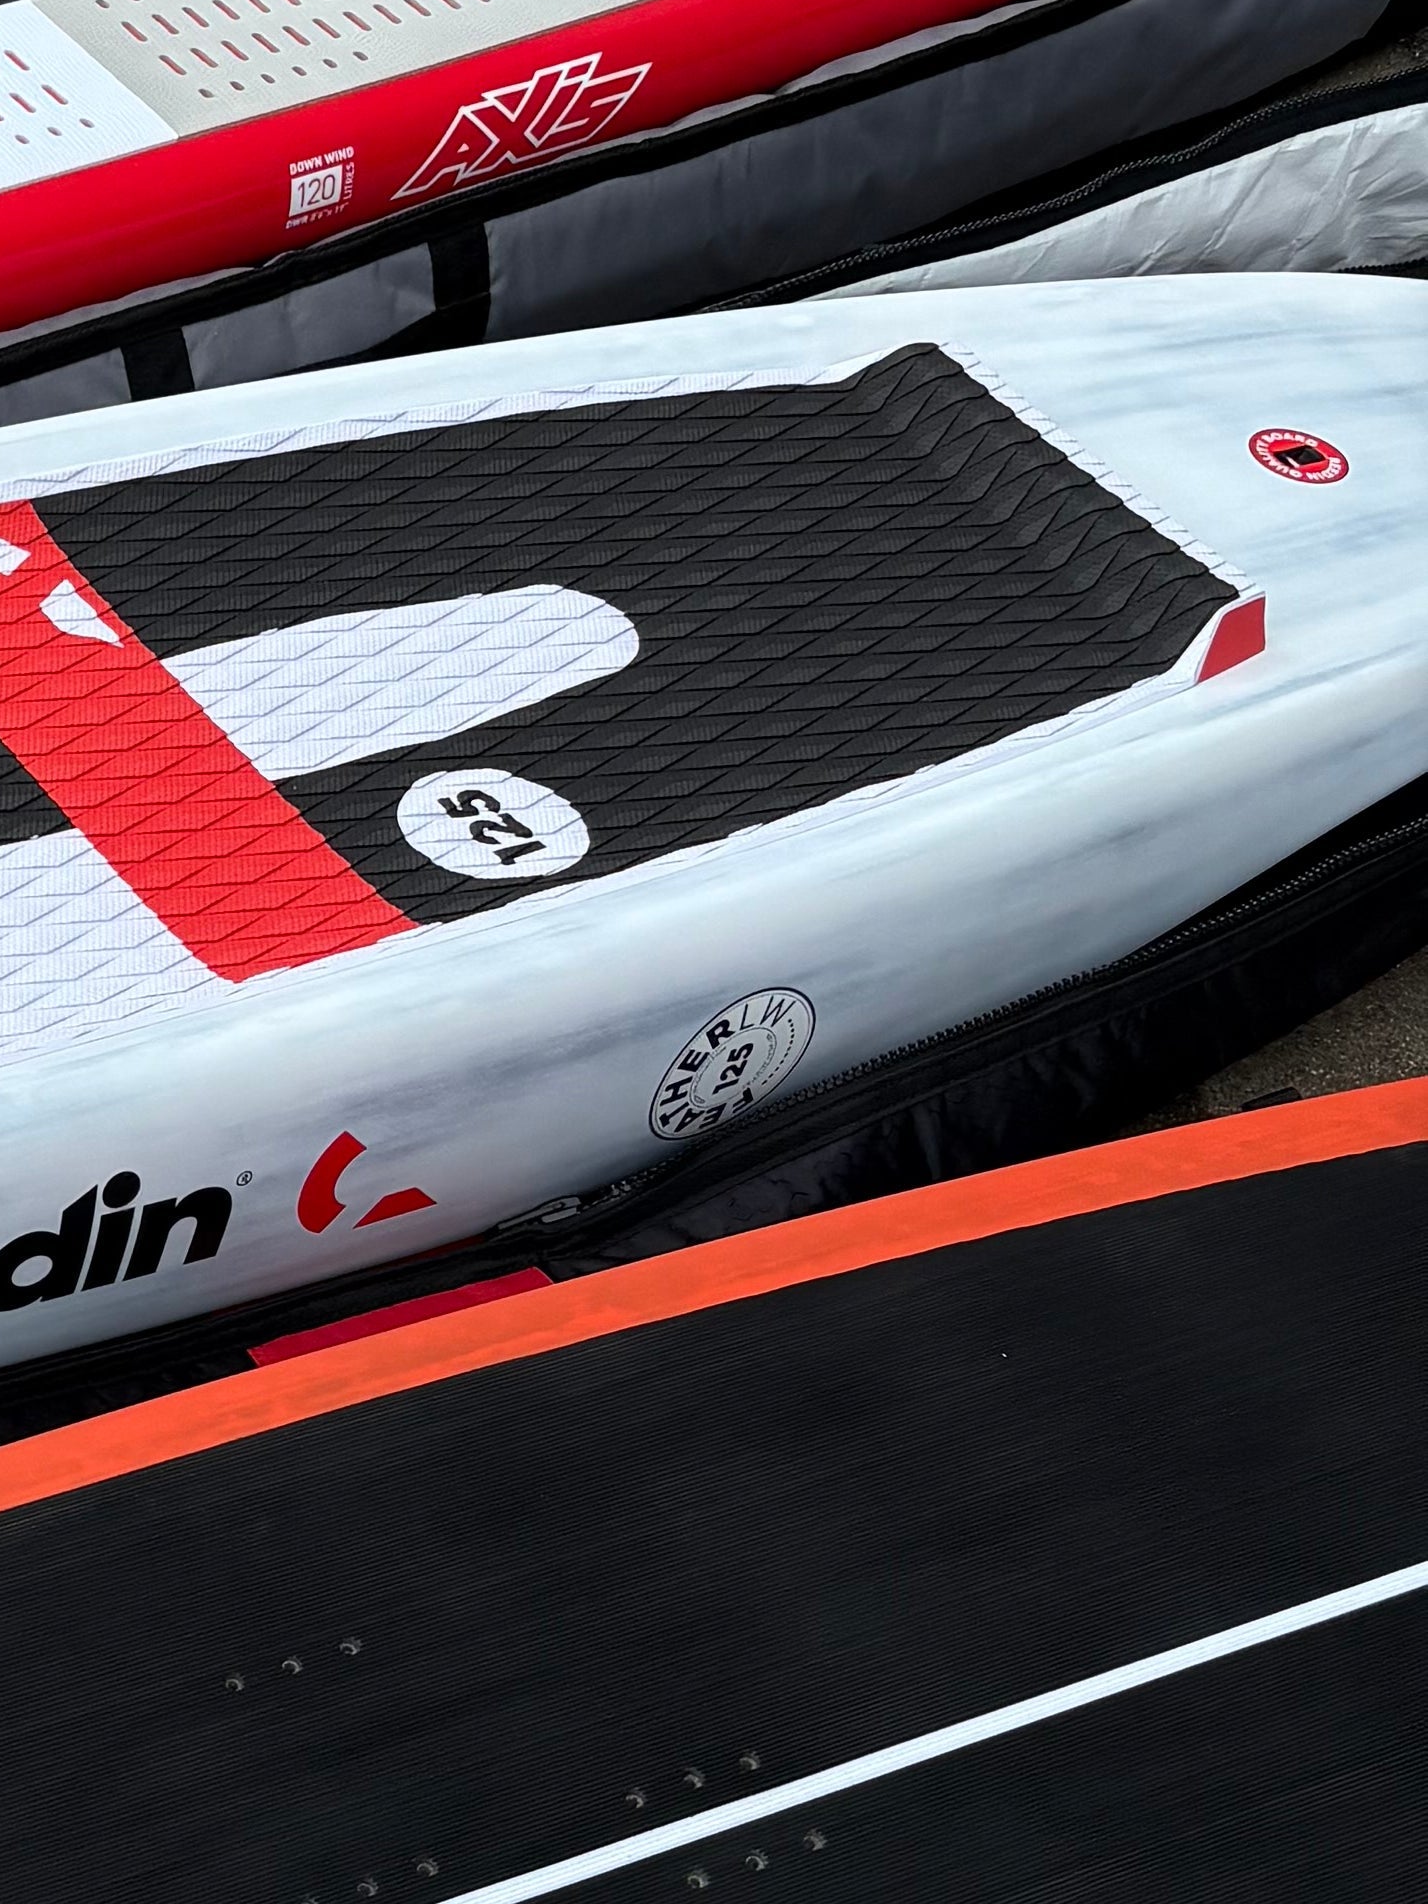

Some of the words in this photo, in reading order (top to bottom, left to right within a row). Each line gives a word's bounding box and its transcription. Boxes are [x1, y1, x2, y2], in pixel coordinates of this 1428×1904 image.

[390, 51, 653, 201] AXIS
[289, 155, 323, 175] DOWN
[324, 145, 355, 165] WIND
[297, 174, 336, 208] 120
[438, 788, 547, 866] 125
[659, 1019, 753, 1133] FEATHER
[712, 1042, 754, 1095] 125
